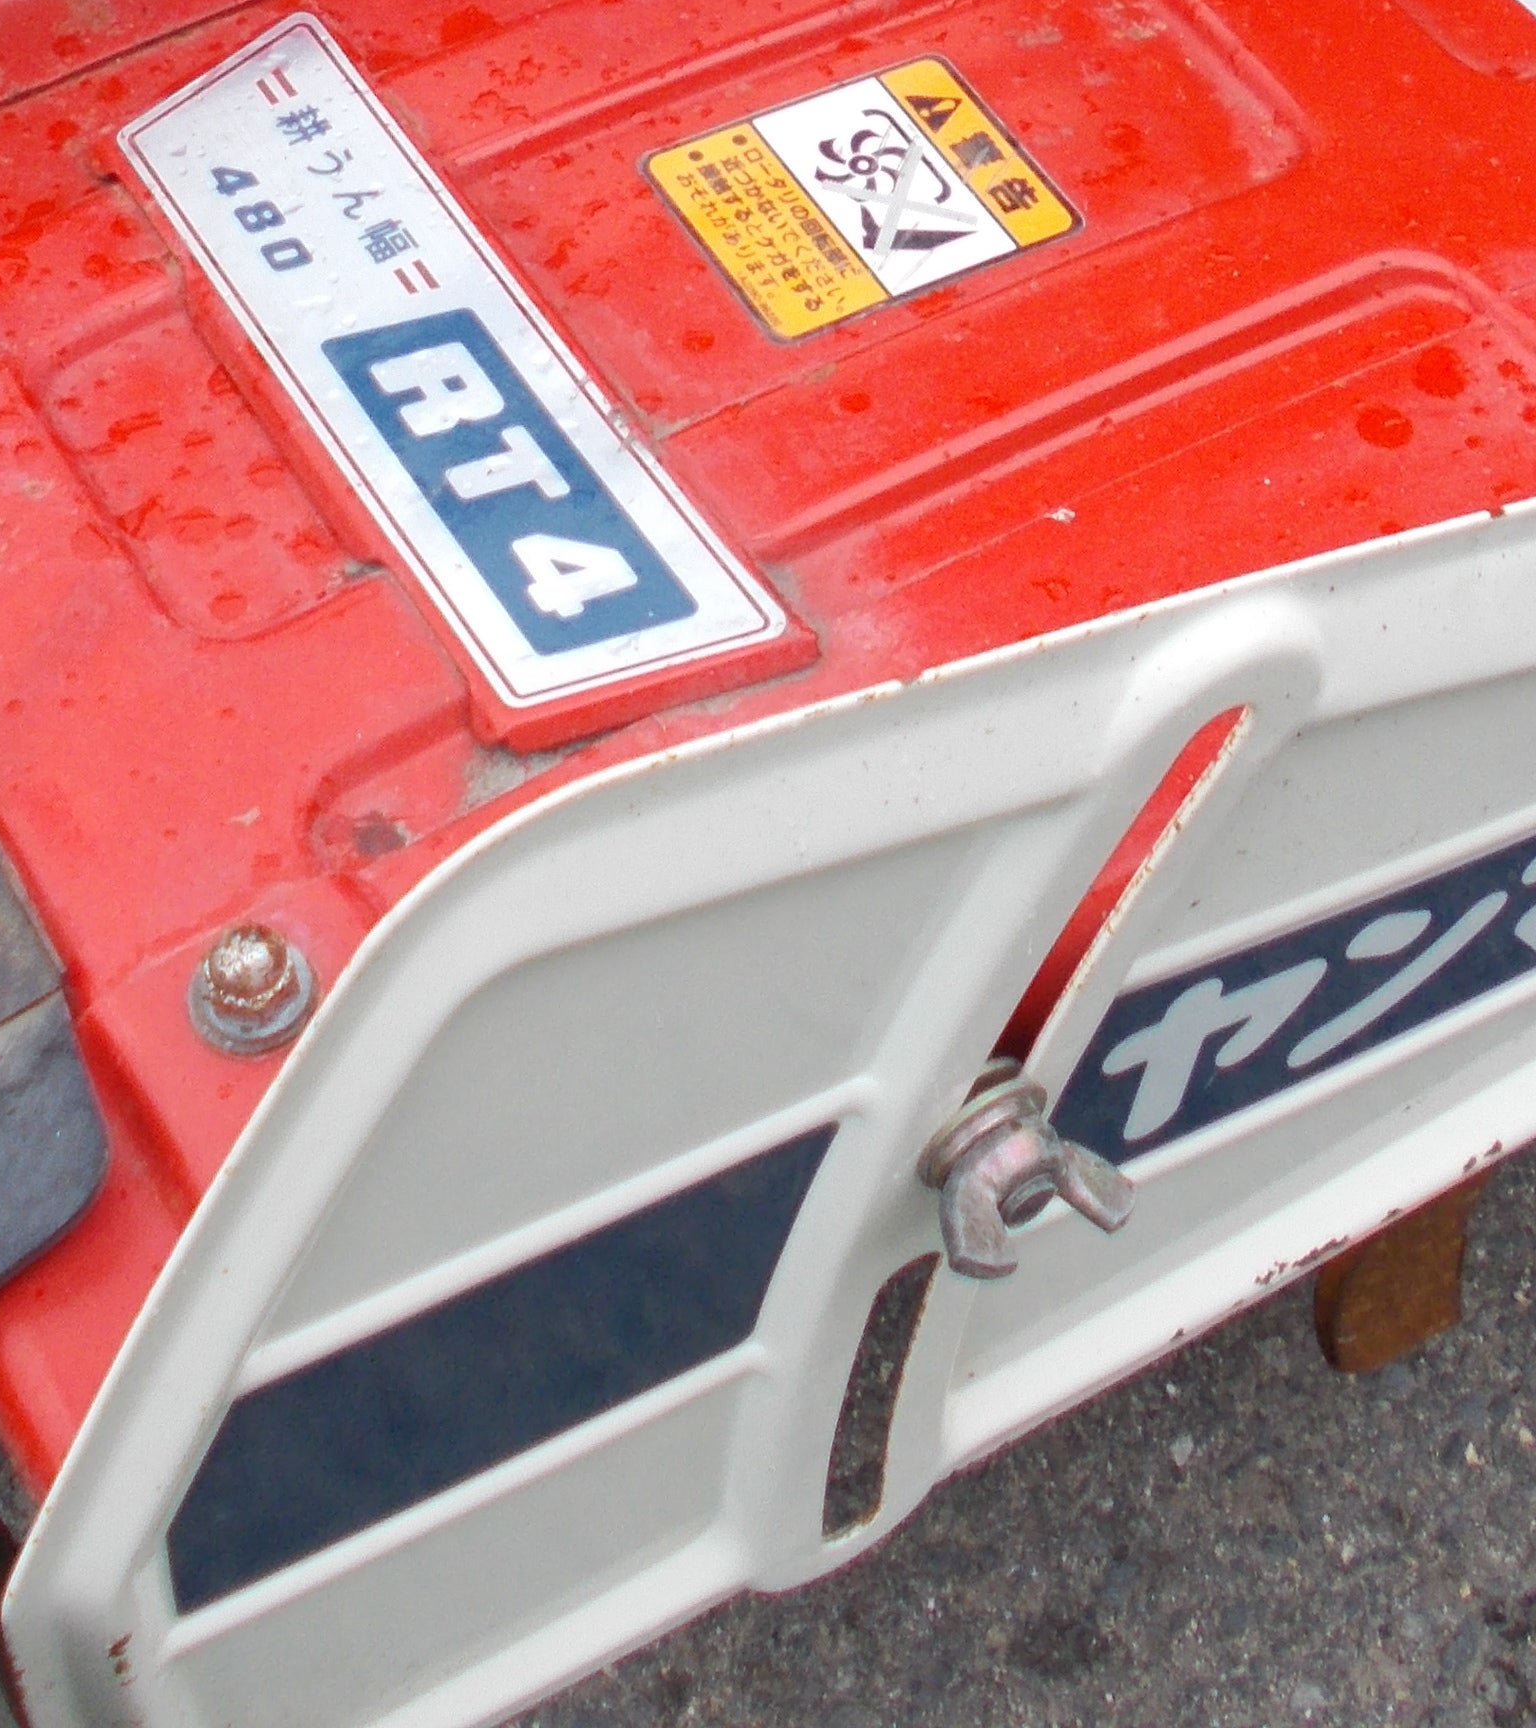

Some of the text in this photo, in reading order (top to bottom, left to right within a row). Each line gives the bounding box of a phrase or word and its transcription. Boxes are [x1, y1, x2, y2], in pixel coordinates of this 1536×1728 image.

[210, 164, 313, 272] 480
[949, 130, 1041, 216] 警告
[368, 342, 639, 618] RT4
